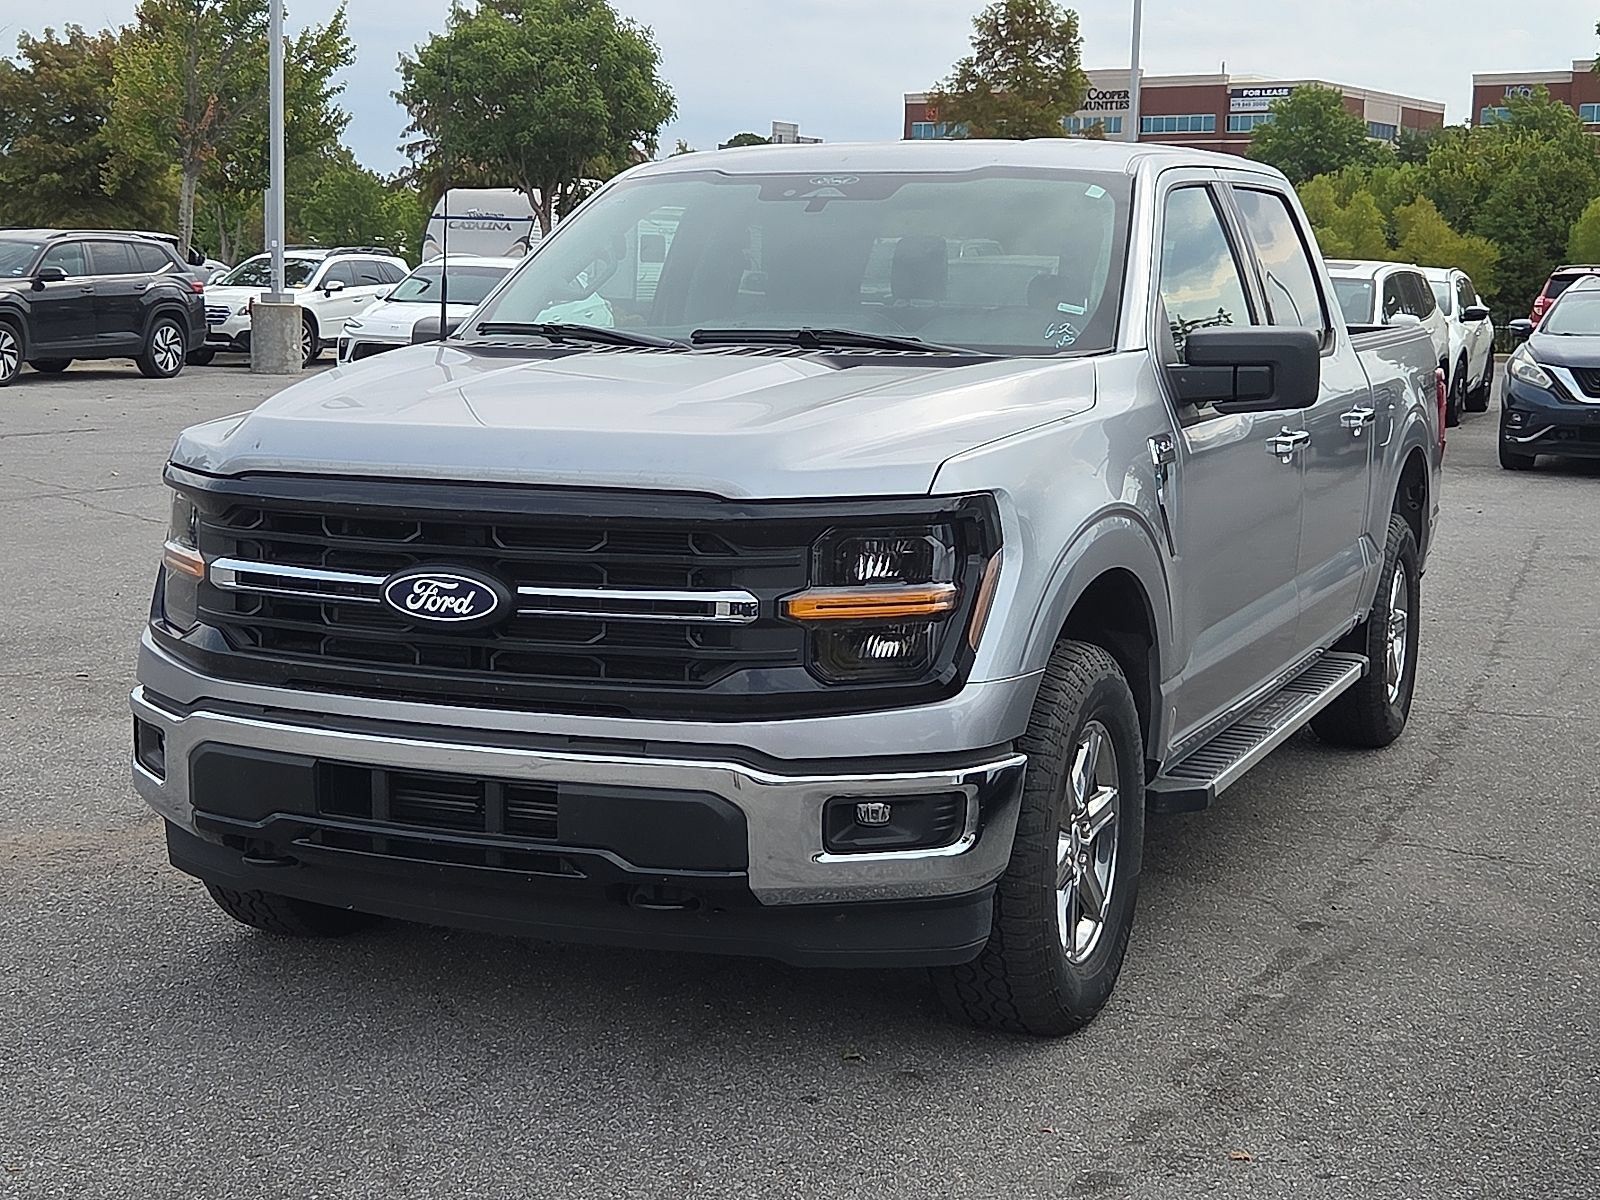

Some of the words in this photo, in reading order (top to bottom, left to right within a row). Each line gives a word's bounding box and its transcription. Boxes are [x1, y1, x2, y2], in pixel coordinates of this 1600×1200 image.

[1087, 87, 1130, 100] COOPER
[1242, 89, 1261, 97] FOR
[1261, 88, 1289, 96] LEASE
[448, 220, 512, 231] CATALINA
[405, 579, 476, 615] Ford
